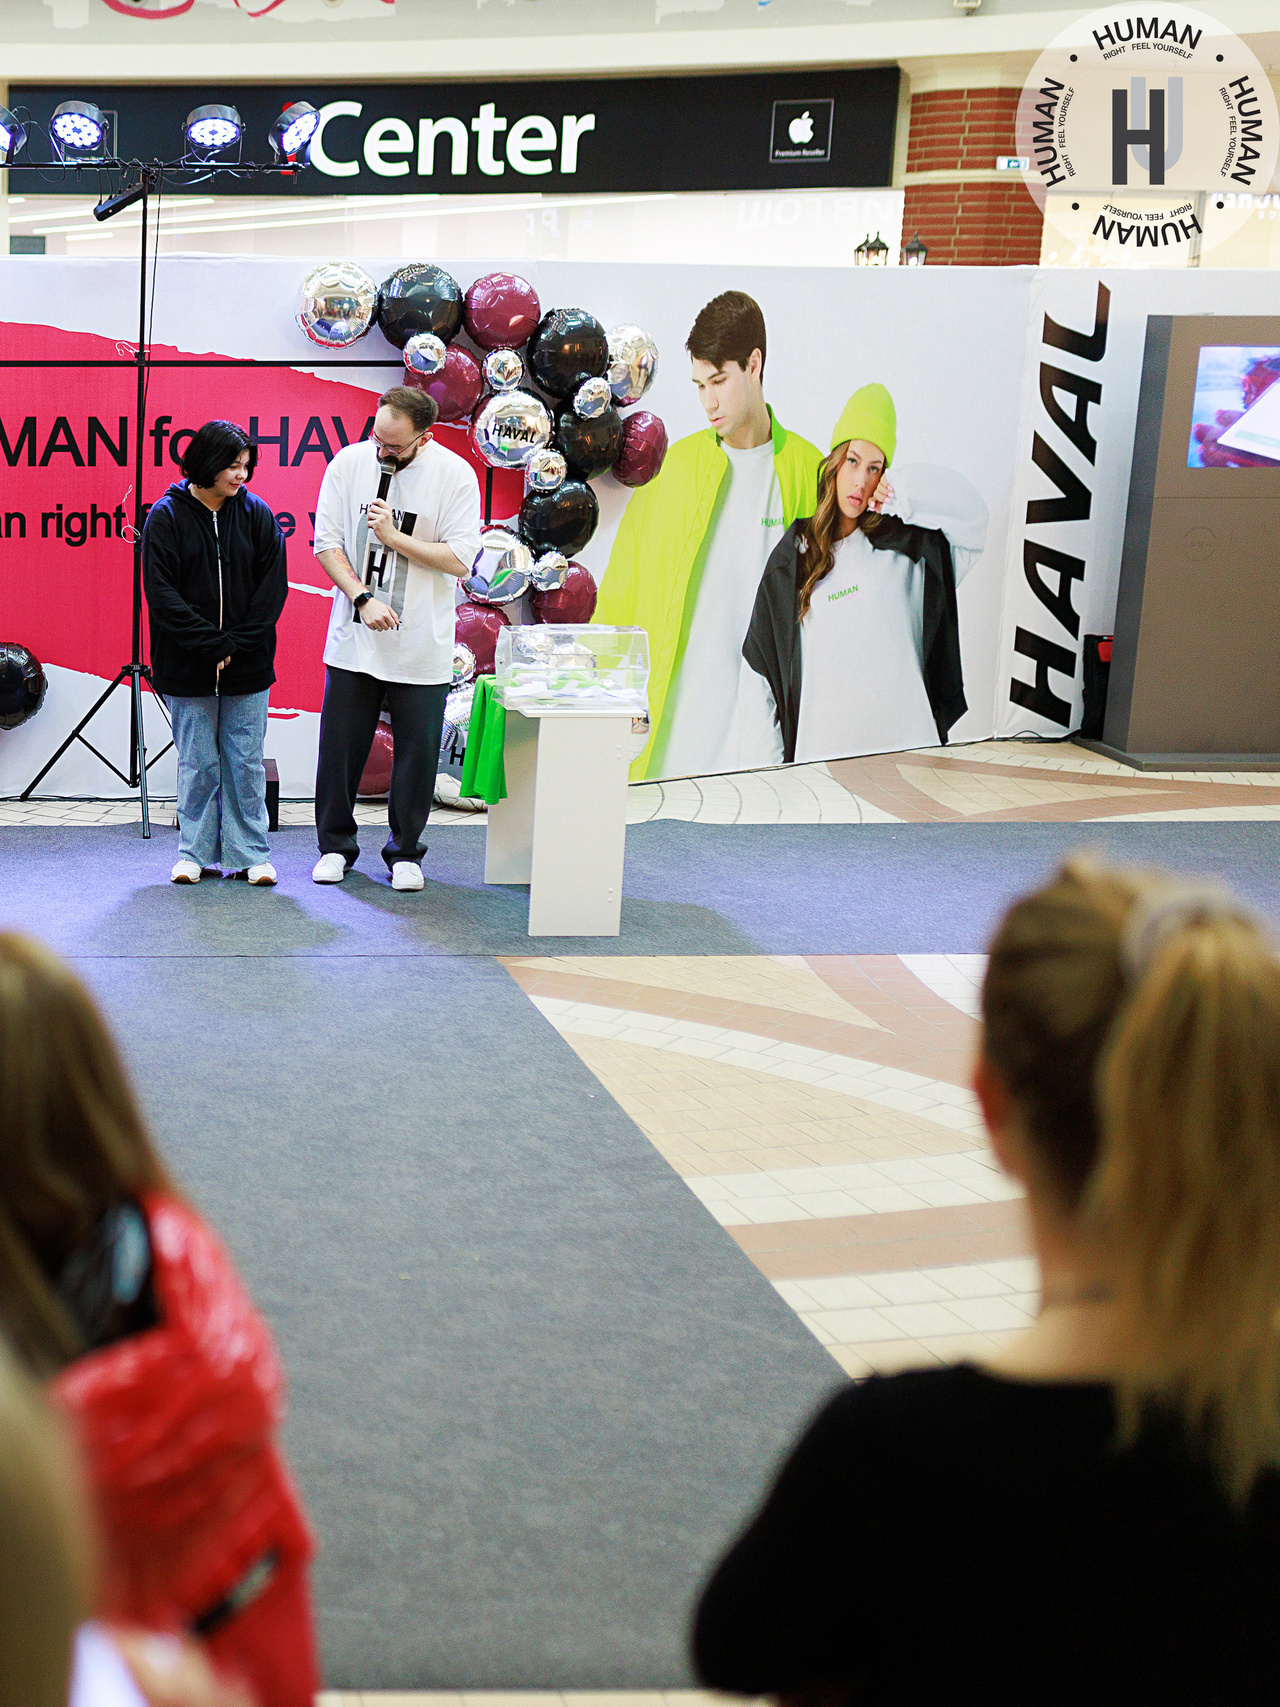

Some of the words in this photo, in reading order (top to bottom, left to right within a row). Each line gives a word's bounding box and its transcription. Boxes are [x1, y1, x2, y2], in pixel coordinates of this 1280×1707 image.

[149, 415, 199, 467] fo
[248, 416, 377, 467] HAV
[491, 423, 536, 444] HAVAL
[41, 503, 127, 547] right
[1009, 280, 1111, 729] HAVAL
[827, 584, 859, 602] HUMAN
